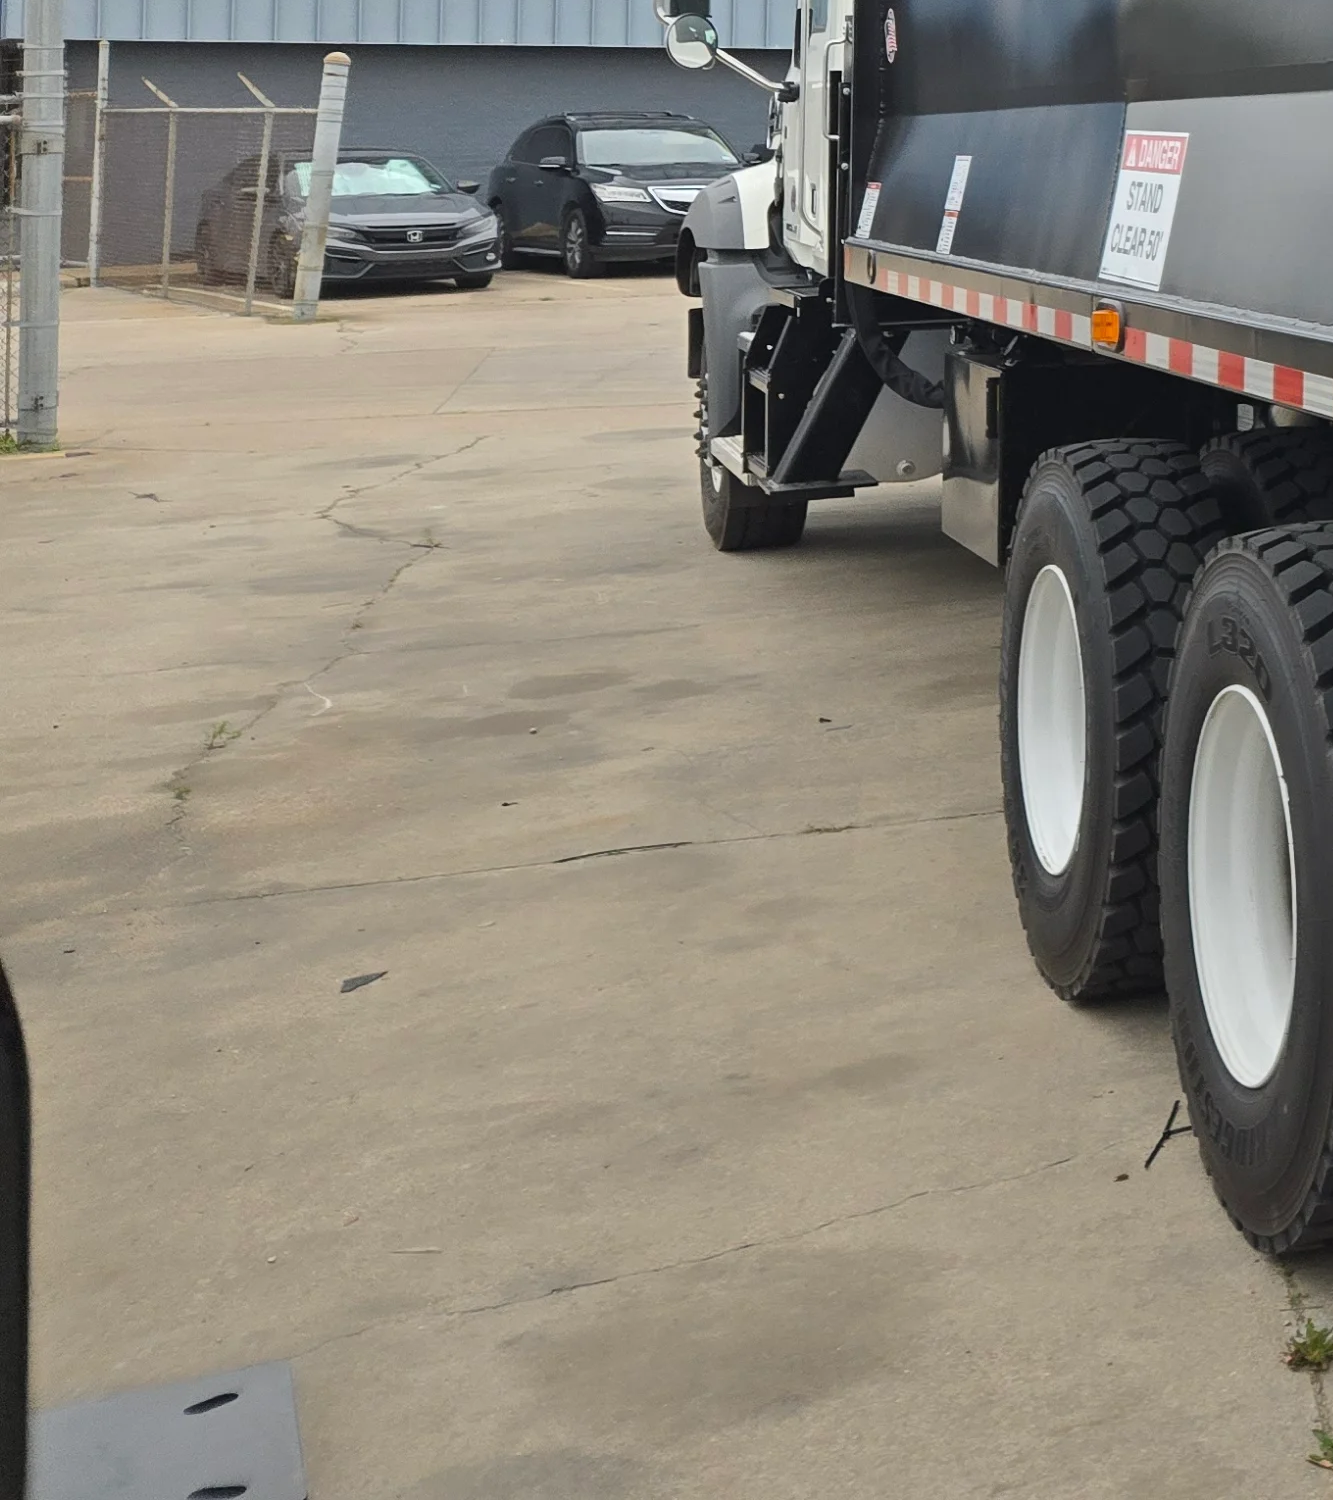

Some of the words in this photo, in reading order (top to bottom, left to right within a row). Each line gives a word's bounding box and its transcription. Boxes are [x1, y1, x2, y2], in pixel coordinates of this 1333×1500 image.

[1138, 140, 1181, 169] DANGER
[1127, 181, 1163, 213] STAND
[1111, 224, 1146, 257] CLEAR
